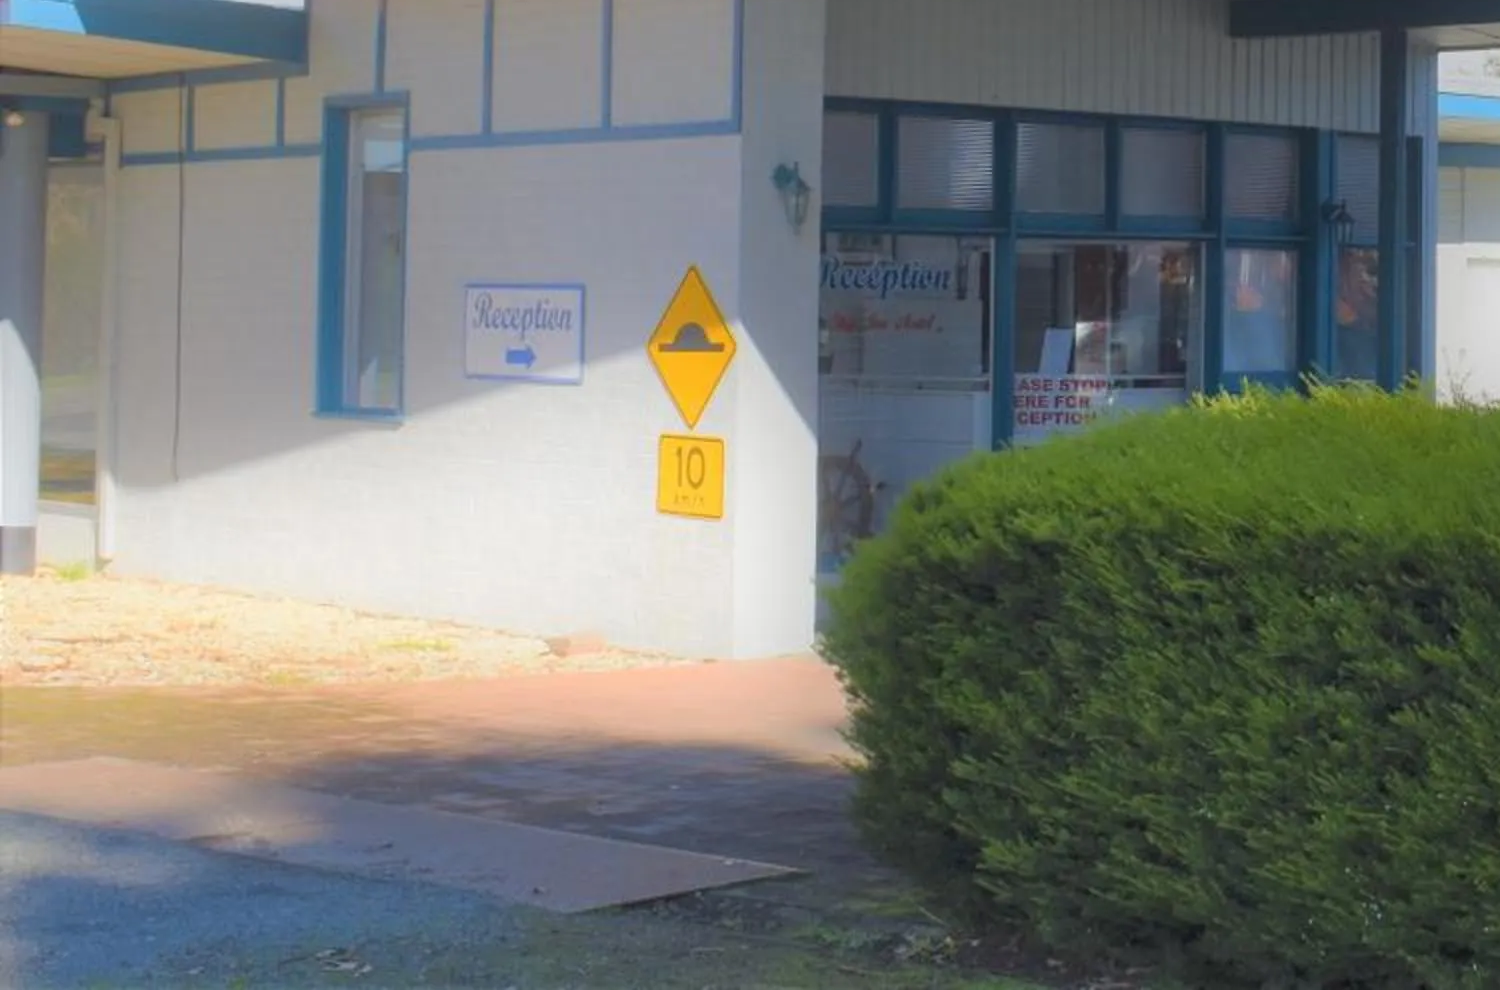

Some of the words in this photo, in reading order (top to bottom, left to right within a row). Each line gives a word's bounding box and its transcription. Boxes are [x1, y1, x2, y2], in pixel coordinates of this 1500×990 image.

[820, 257, 951, 299] Reception
[472, 291, 573, 341] Reception
[1018, 378, 1053, 392] ASE
[1013, 395, 1049, 408] ERE
[1054, 395, 1090, 409] FOR
[1017, 411, 1097, 425] CEPTIO
[676, 445, 706, 490] 10
